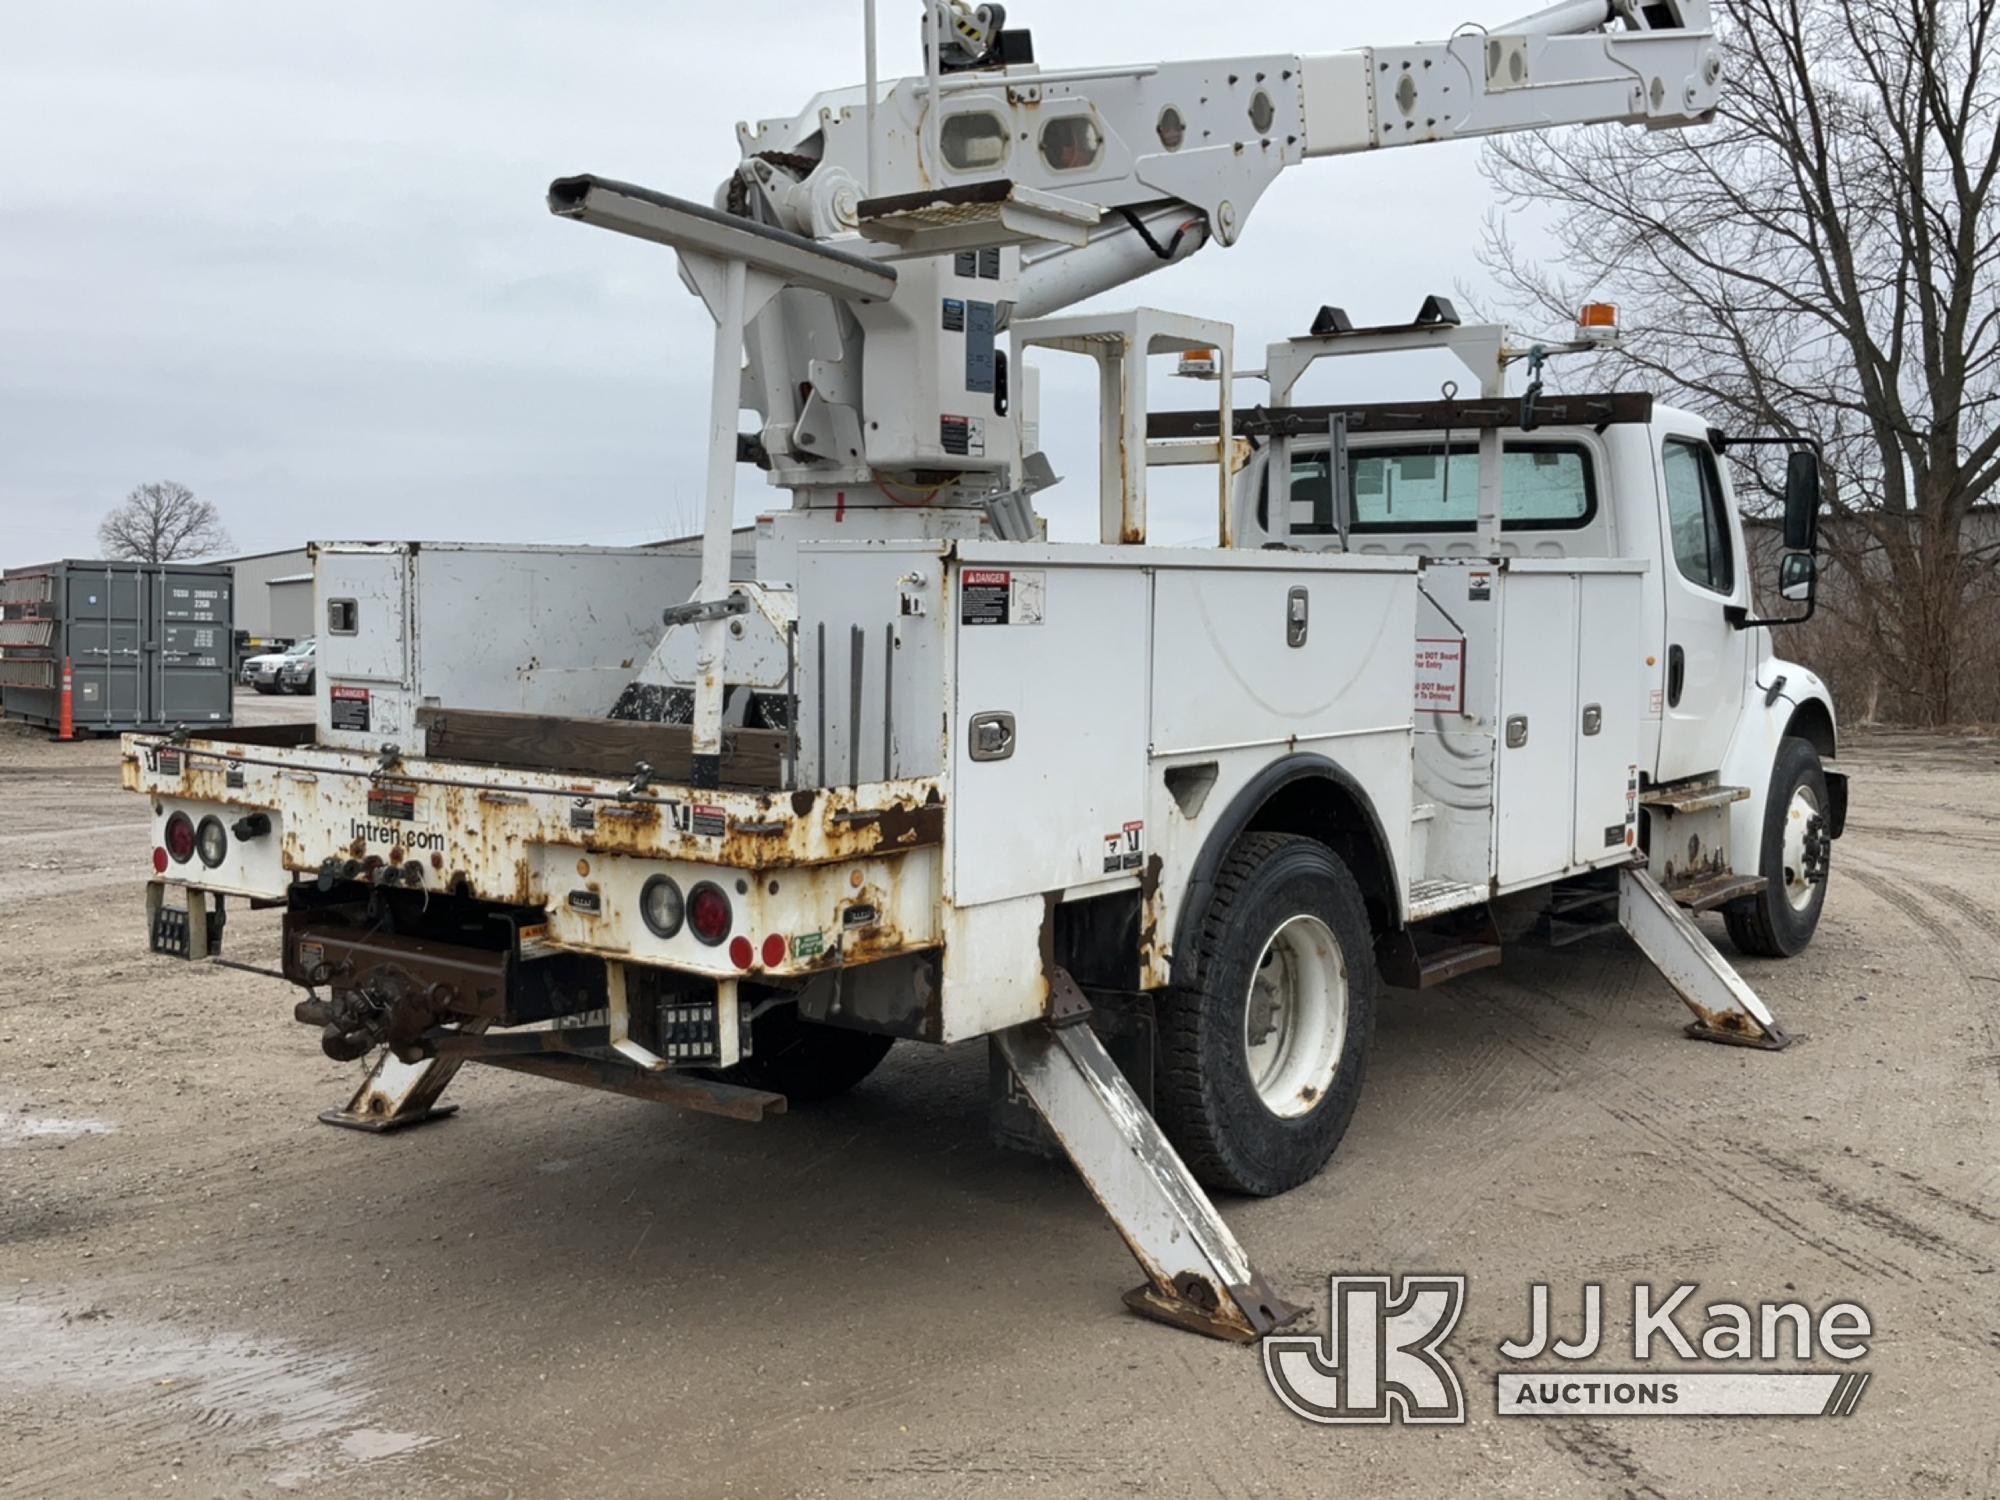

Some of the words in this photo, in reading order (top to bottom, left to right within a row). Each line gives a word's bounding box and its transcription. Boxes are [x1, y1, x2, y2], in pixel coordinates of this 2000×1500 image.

[975, 573, 1005, 584] DANGER
[1425, 652, 1438, 660] DOT
[1440, 652, 1459, 660] Board
[1426, 660, 1442, 670] Entry
[1437, 683, 1456, 692] Board
[1429, 691, 1451, 702] Driving
[351, 817, 444, 851] Intren.com
